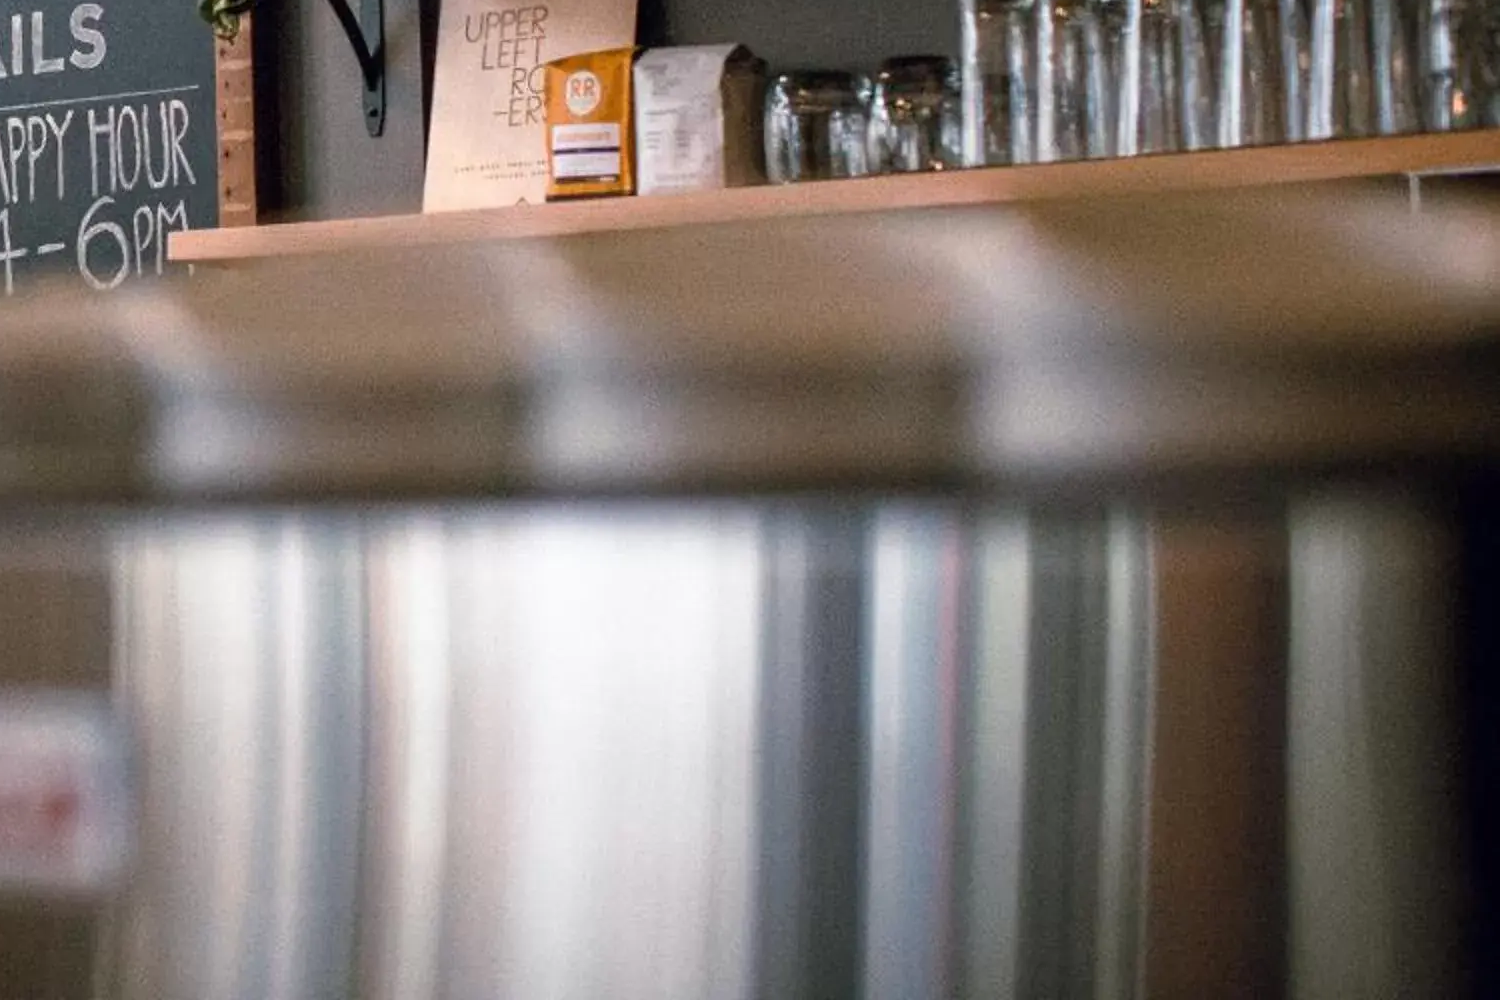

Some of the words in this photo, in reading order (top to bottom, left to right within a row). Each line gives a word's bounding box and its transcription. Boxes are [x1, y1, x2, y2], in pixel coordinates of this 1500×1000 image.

[465, 5, 549, 43] UPPER
[481, 35, 547, 71] LEFT
[493, 95, 548, 127] -ER
[88, 99, 197, 197] HOUR
